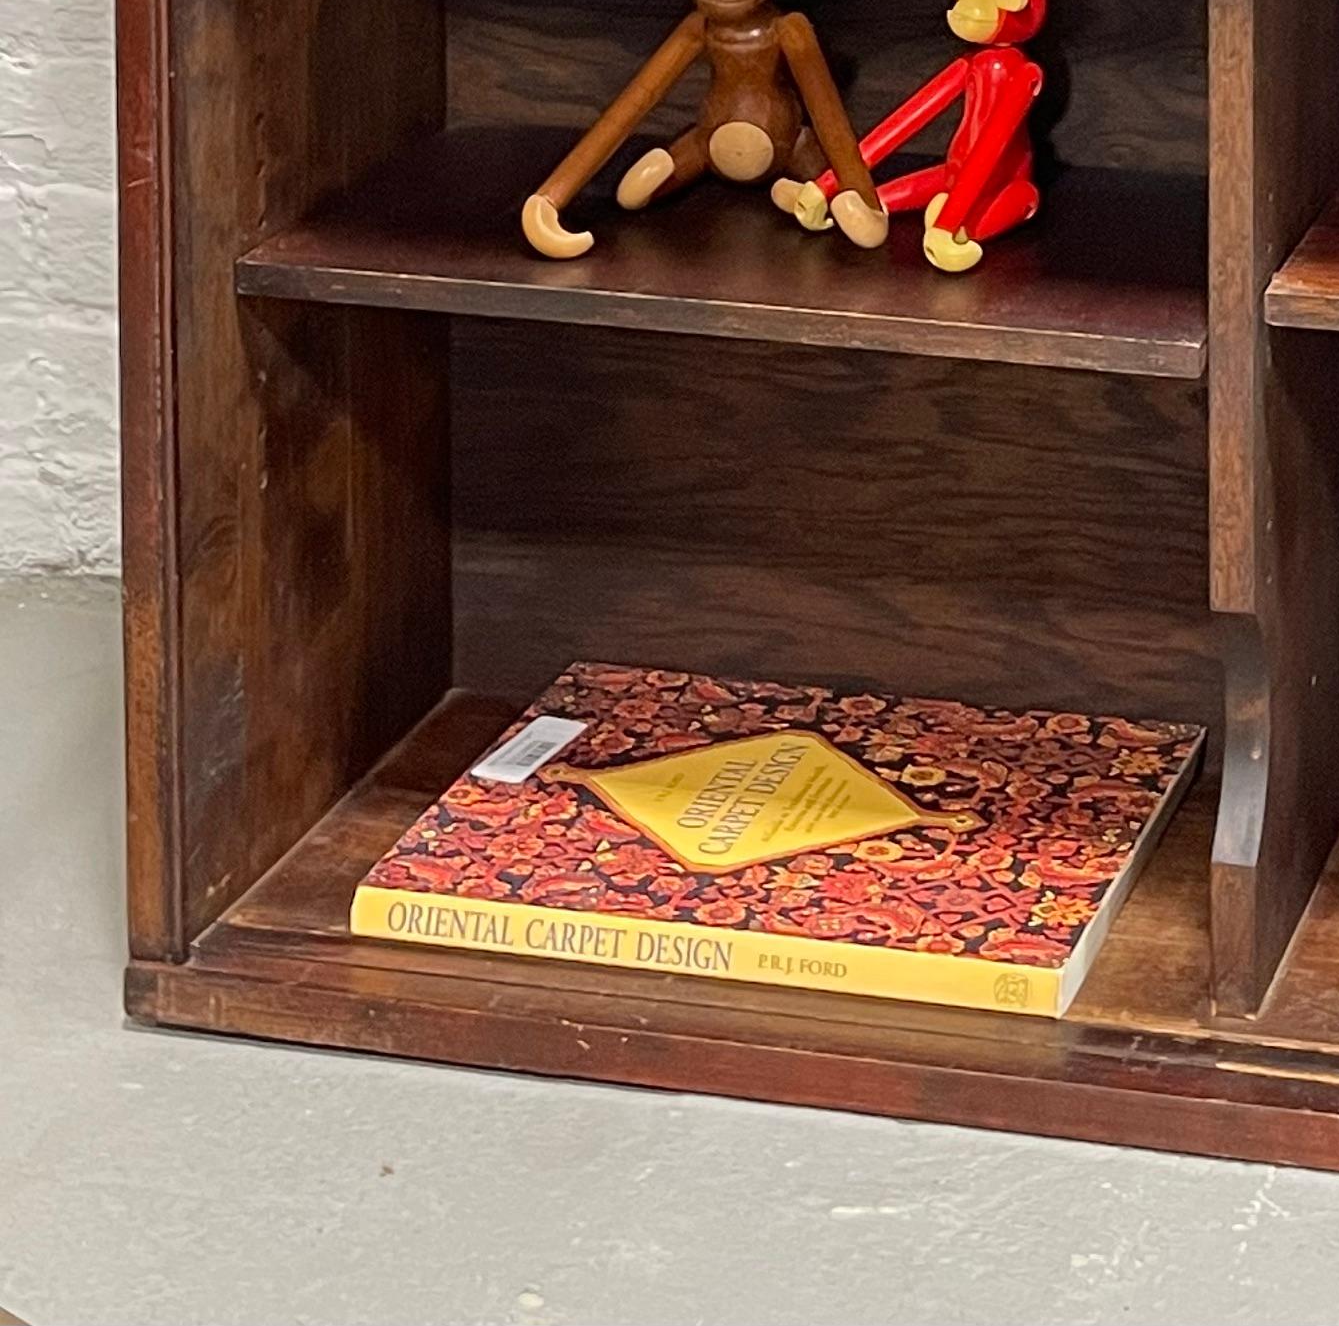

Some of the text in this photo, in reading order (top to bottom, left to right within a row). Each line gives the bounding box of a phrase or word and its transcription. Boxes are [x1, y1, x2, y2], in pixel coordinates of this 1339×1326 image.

[677, 759, 758, 829] ORIENTAL
[698, 794, 766, 855] CARPET
[745, 742, 810, 796] DESIGN
[387, 901, 734, 973] ORIENTAL CARPET DESIGN
[799, 958, 848, 979] FORD
